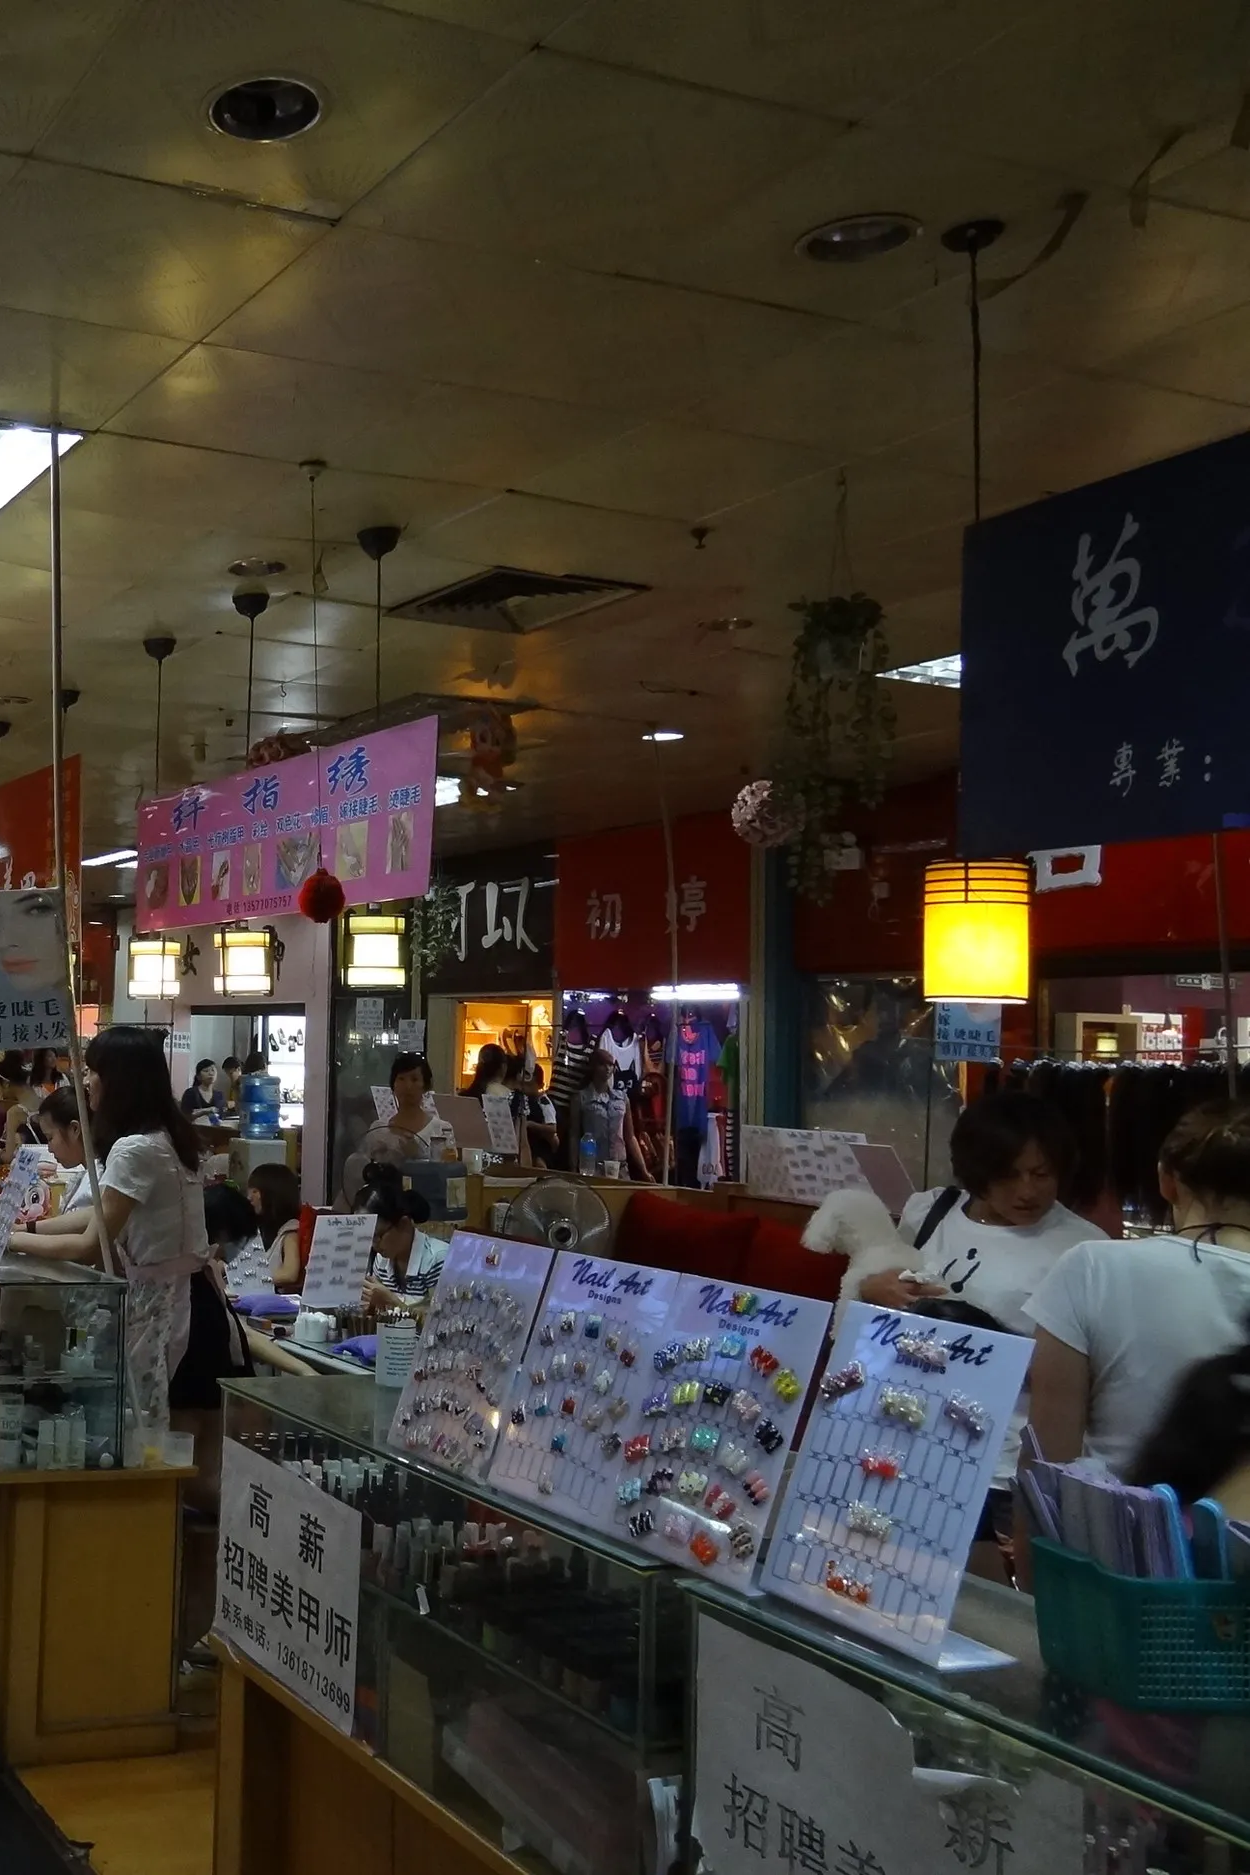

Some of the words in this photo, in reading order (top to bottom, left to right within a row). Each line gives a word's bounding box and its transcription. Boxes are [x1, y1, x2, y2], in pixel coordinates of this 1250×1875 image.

[1062, 512, 1159, 678] 萬
[172, 747, 371, 832] 纤指绣
[12, 1020, 68, 1042] 接头发
[573, 1257, 616, 1290] Nail
[612, 1271, 654, 1298] Art
[588, 1290, 622, 1305] Designs
[749, 1299, 799, 1329] Art
[718, 1318, 760, 1338] Designs
[944, 1333, 994, 1366] Art
[249, 1483, 326, 1574] 高薪
[223, 1536, 352, 1668] 招聘美甲师
